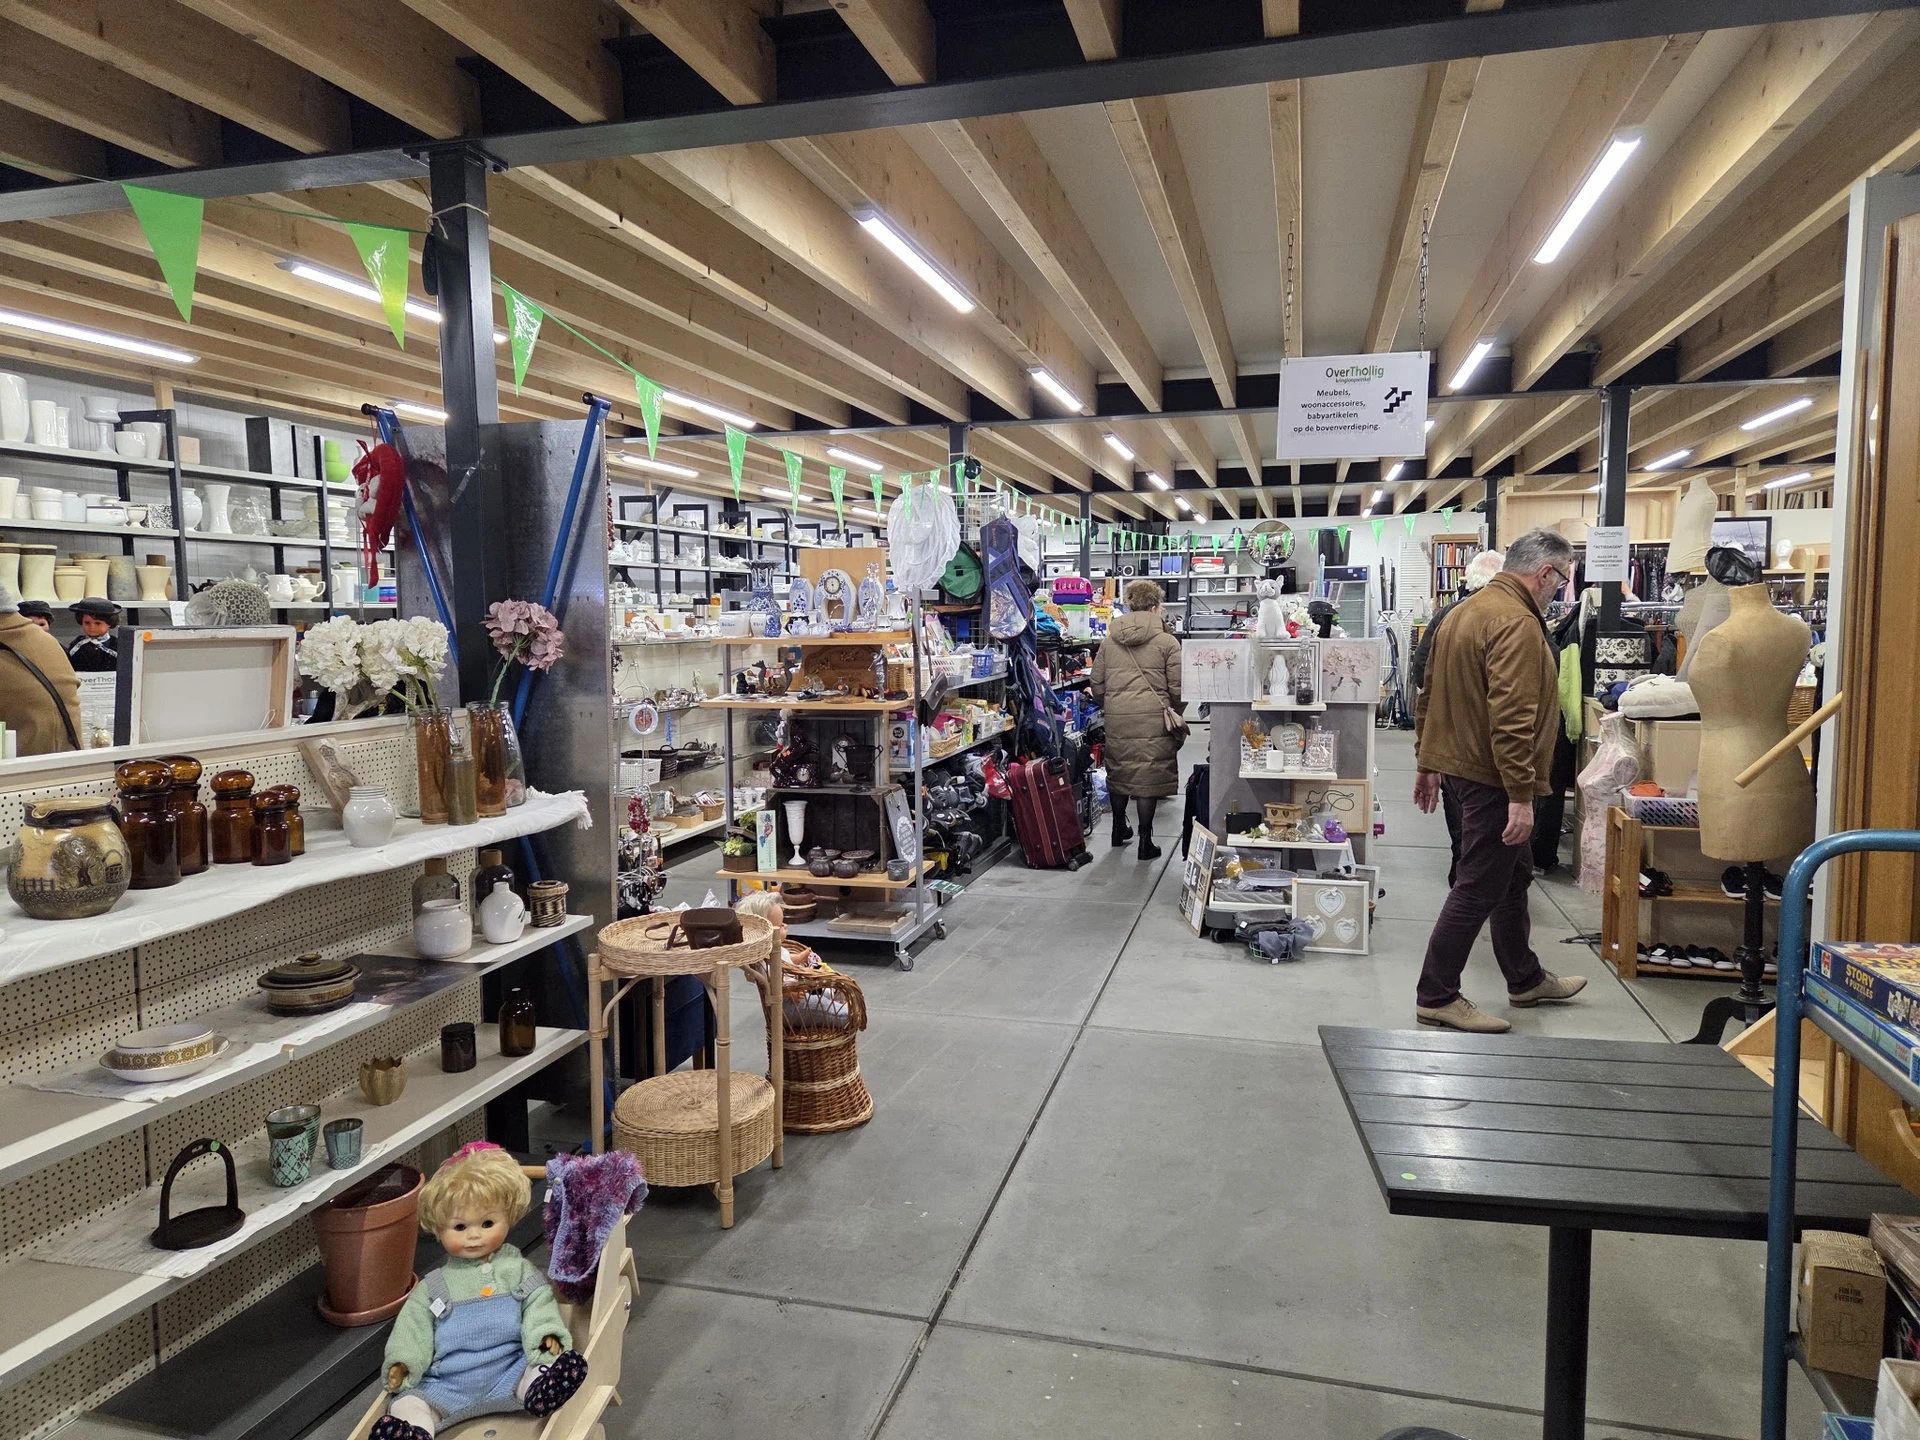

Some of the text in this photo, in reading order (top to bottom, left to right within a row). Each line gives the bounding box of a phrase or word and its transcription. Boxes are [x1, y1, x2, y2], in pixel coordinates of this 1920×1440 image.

[1325, 365, 1385, 379] OverThollig
[1316, 389, 1351, 397] Meubels,
[1301, 400, 1366, 409] woonaccessoires,
[1307, 411, 1359, 420] babyartikelen
[1315, 423, 1381, 431] bovenverdieping.
[1845, 963, 1875, 988] STORY
[1845, 977, 1874, 999] 4 PUZZLES
